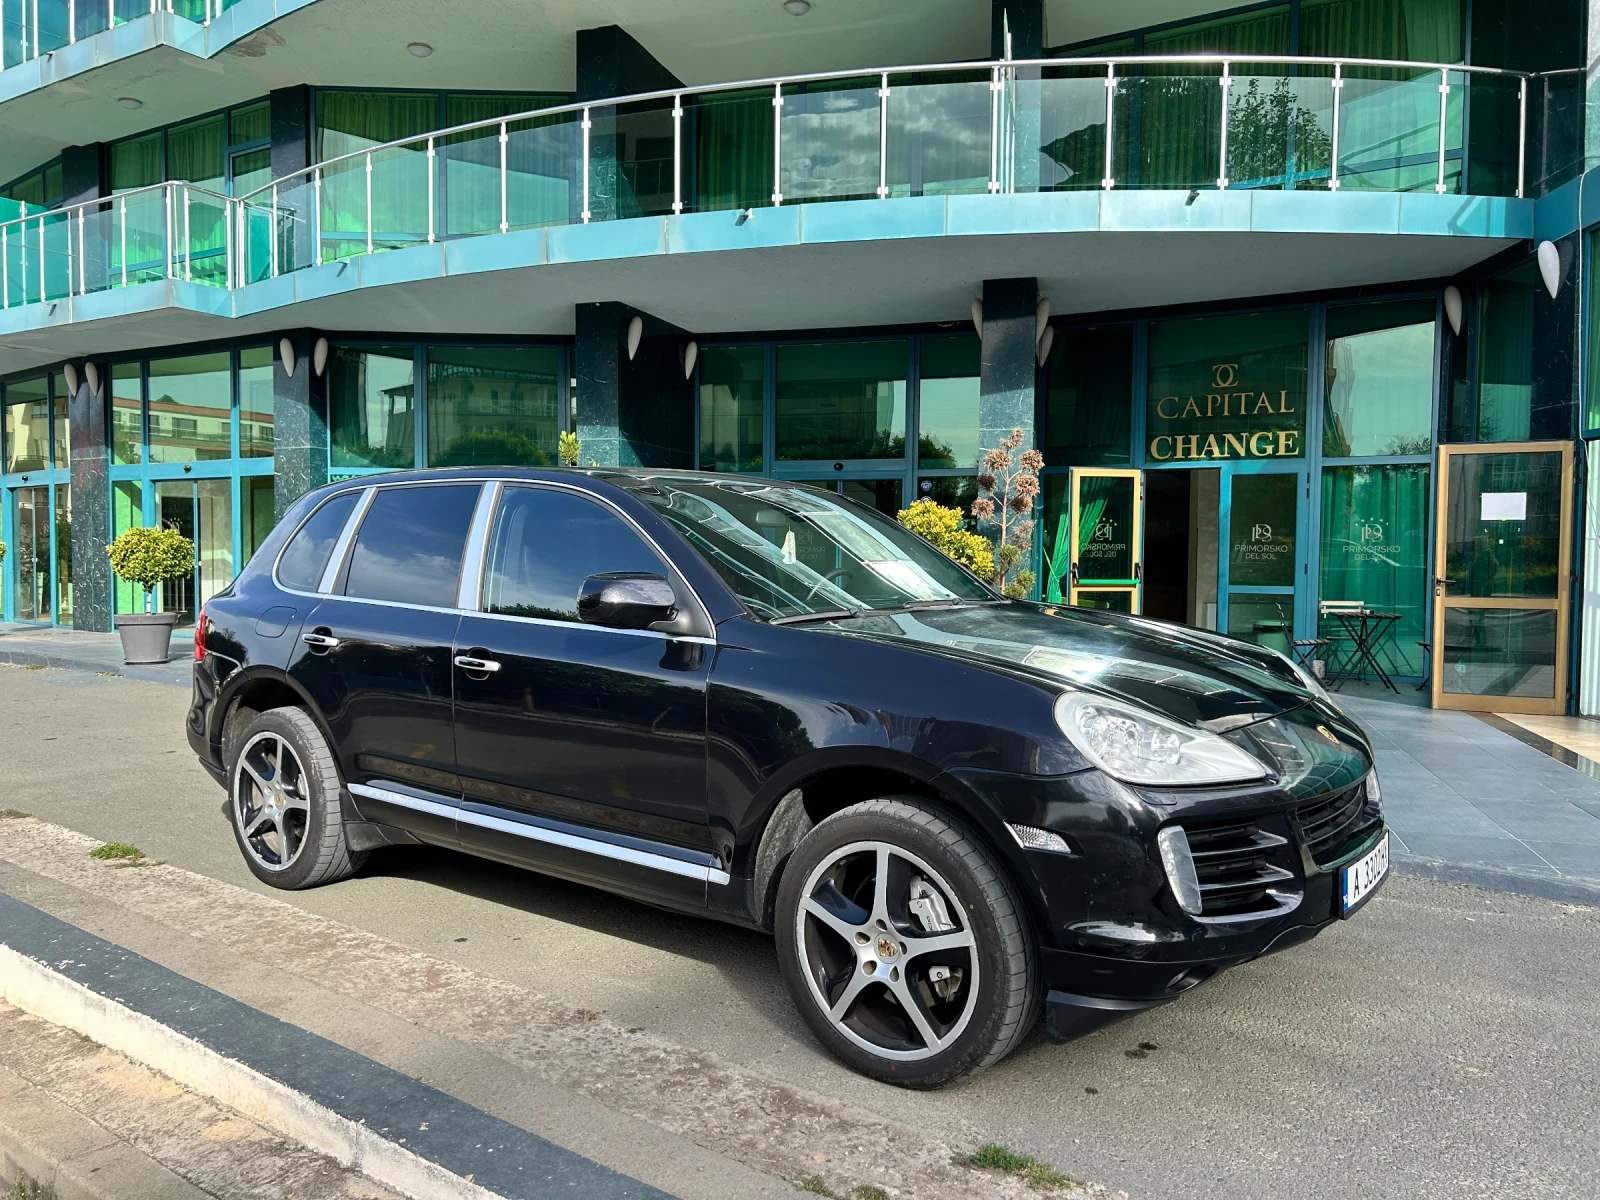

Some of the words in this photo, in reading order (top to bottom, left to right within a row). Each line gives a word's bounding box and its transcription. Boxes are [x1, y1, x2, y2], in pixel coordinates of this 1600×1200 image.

[1156, 390, 1295, 419] CAPITAL
[1150, 430, 1300, 460] CHANGE
[1234, 544, 1289, 553] PRIMORSKO
[1342, 545, 1400, 553] PRIMORSKO
[1245, 552, 1260, 560] DEL
[1261, 552, 1277, 560] SOL
[1354, 553, 1369, 561] DEL
[1353, 867, 1360, 899] A
